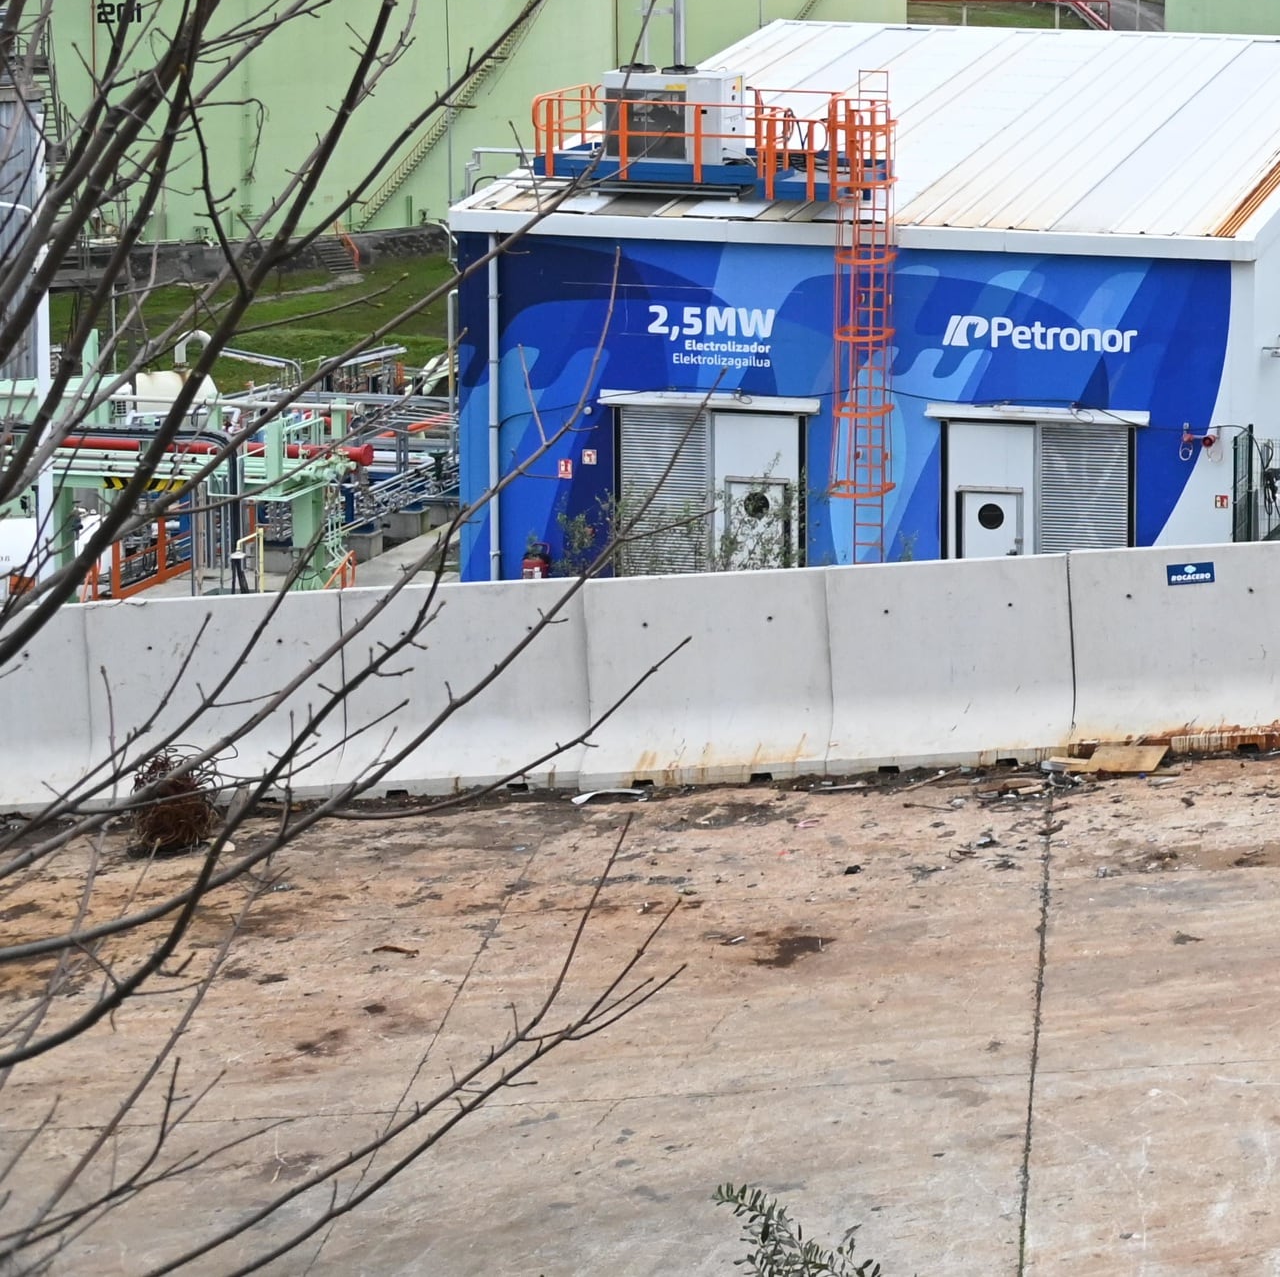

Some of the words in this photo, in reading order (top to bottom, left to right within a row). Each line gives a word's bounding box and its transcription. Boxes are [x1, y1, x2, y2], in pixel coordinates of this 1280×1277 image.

[647, 304, 776, 342] 2,5MW
[990, 315, 1139, 354] Petronor
[684, 339, 772, 354] Electrolizador
[671, 352, 772, 369] Elektrolizagailua
